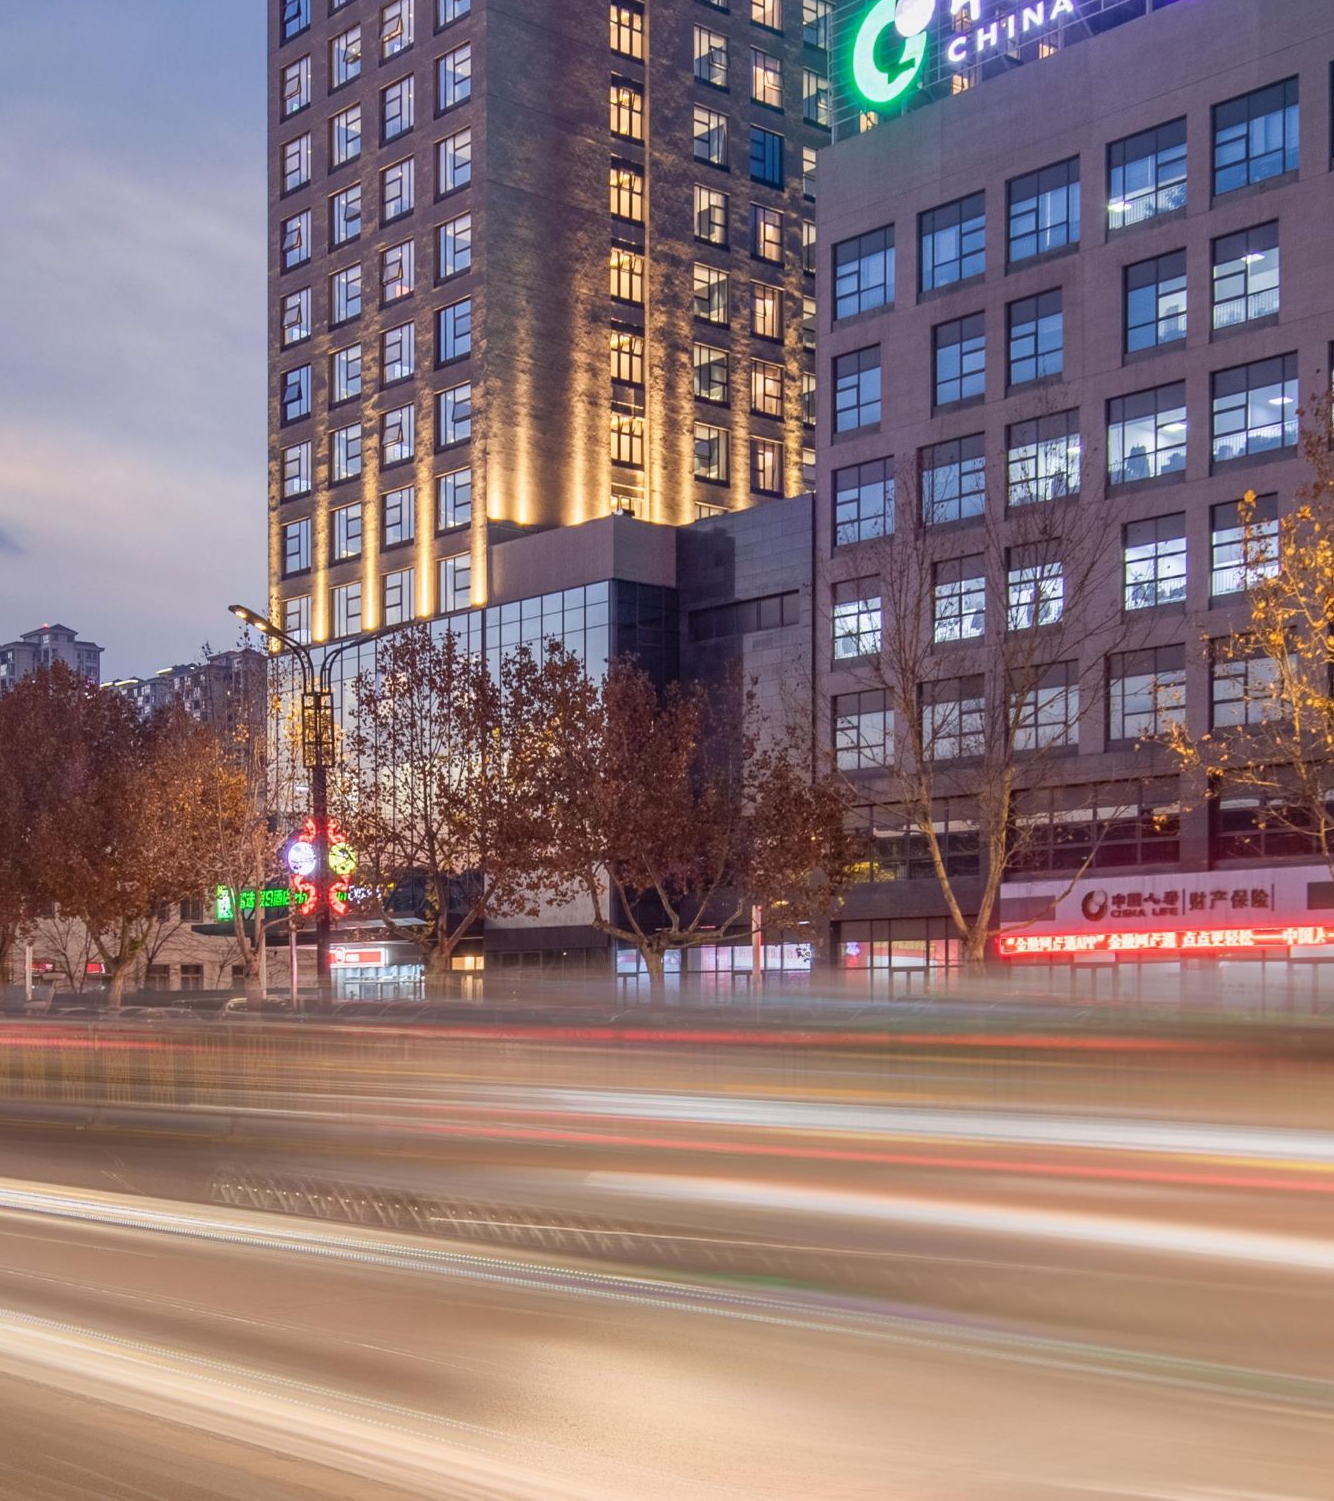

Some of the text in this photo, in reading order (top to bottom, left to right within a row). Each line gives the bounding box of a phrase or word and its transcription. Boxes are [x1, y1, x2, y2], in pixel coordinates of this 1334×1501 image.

[1110, 890, 1180, 908] 中国人寿
[1188, 888, 1270, 912] 财产保险
[1151, 906, 1180, 917] LIFE
